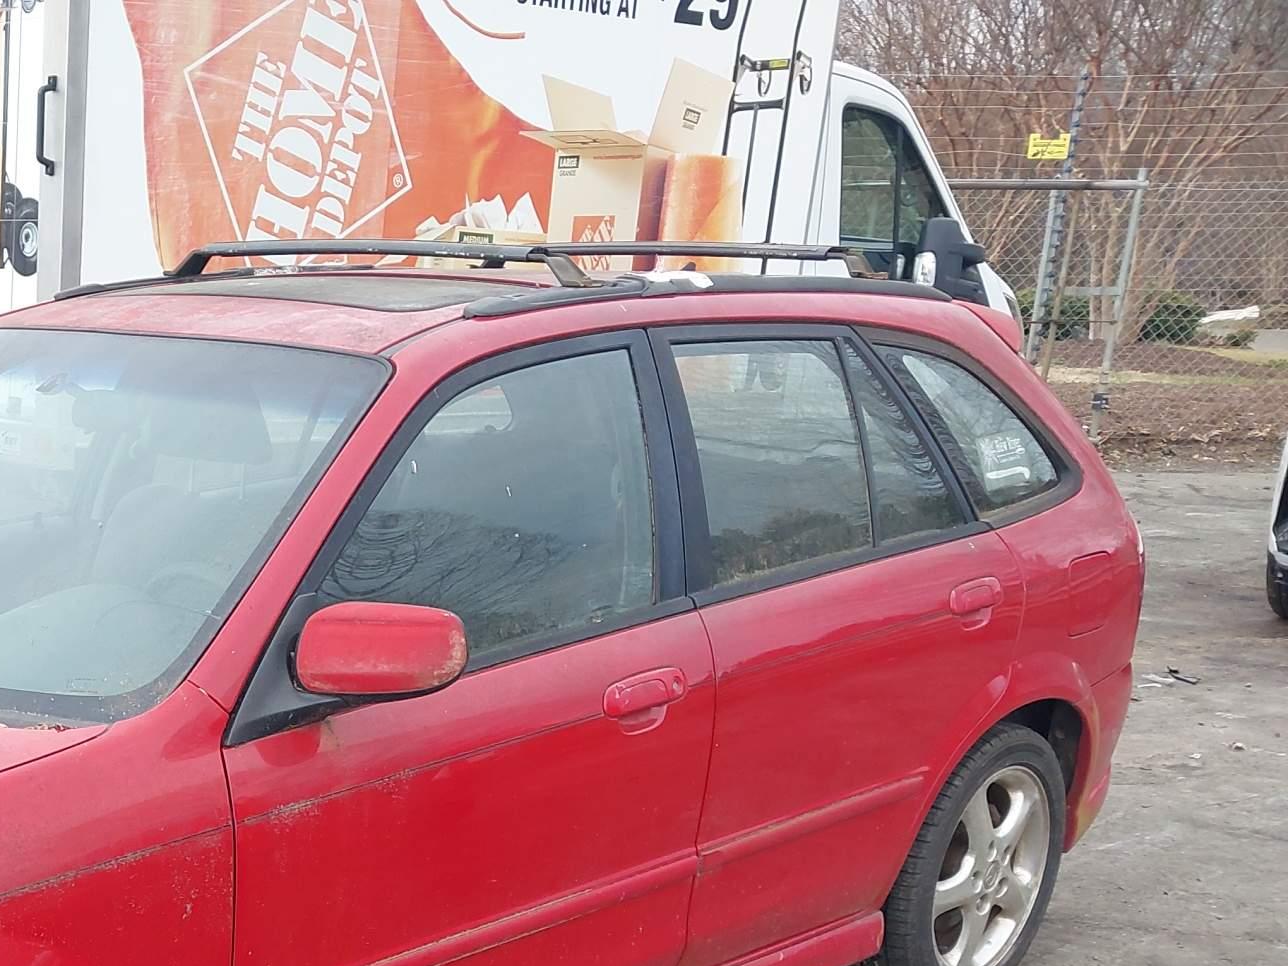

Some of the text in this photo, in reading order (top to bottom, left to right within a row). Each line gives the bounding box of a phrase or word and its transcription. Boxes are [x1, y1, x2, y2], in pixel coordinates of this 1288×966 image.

[231, 52, 287, 162] THE
[312, 57, 381, 239] DEPOT
[559, 156, 579, 168] LARGE
